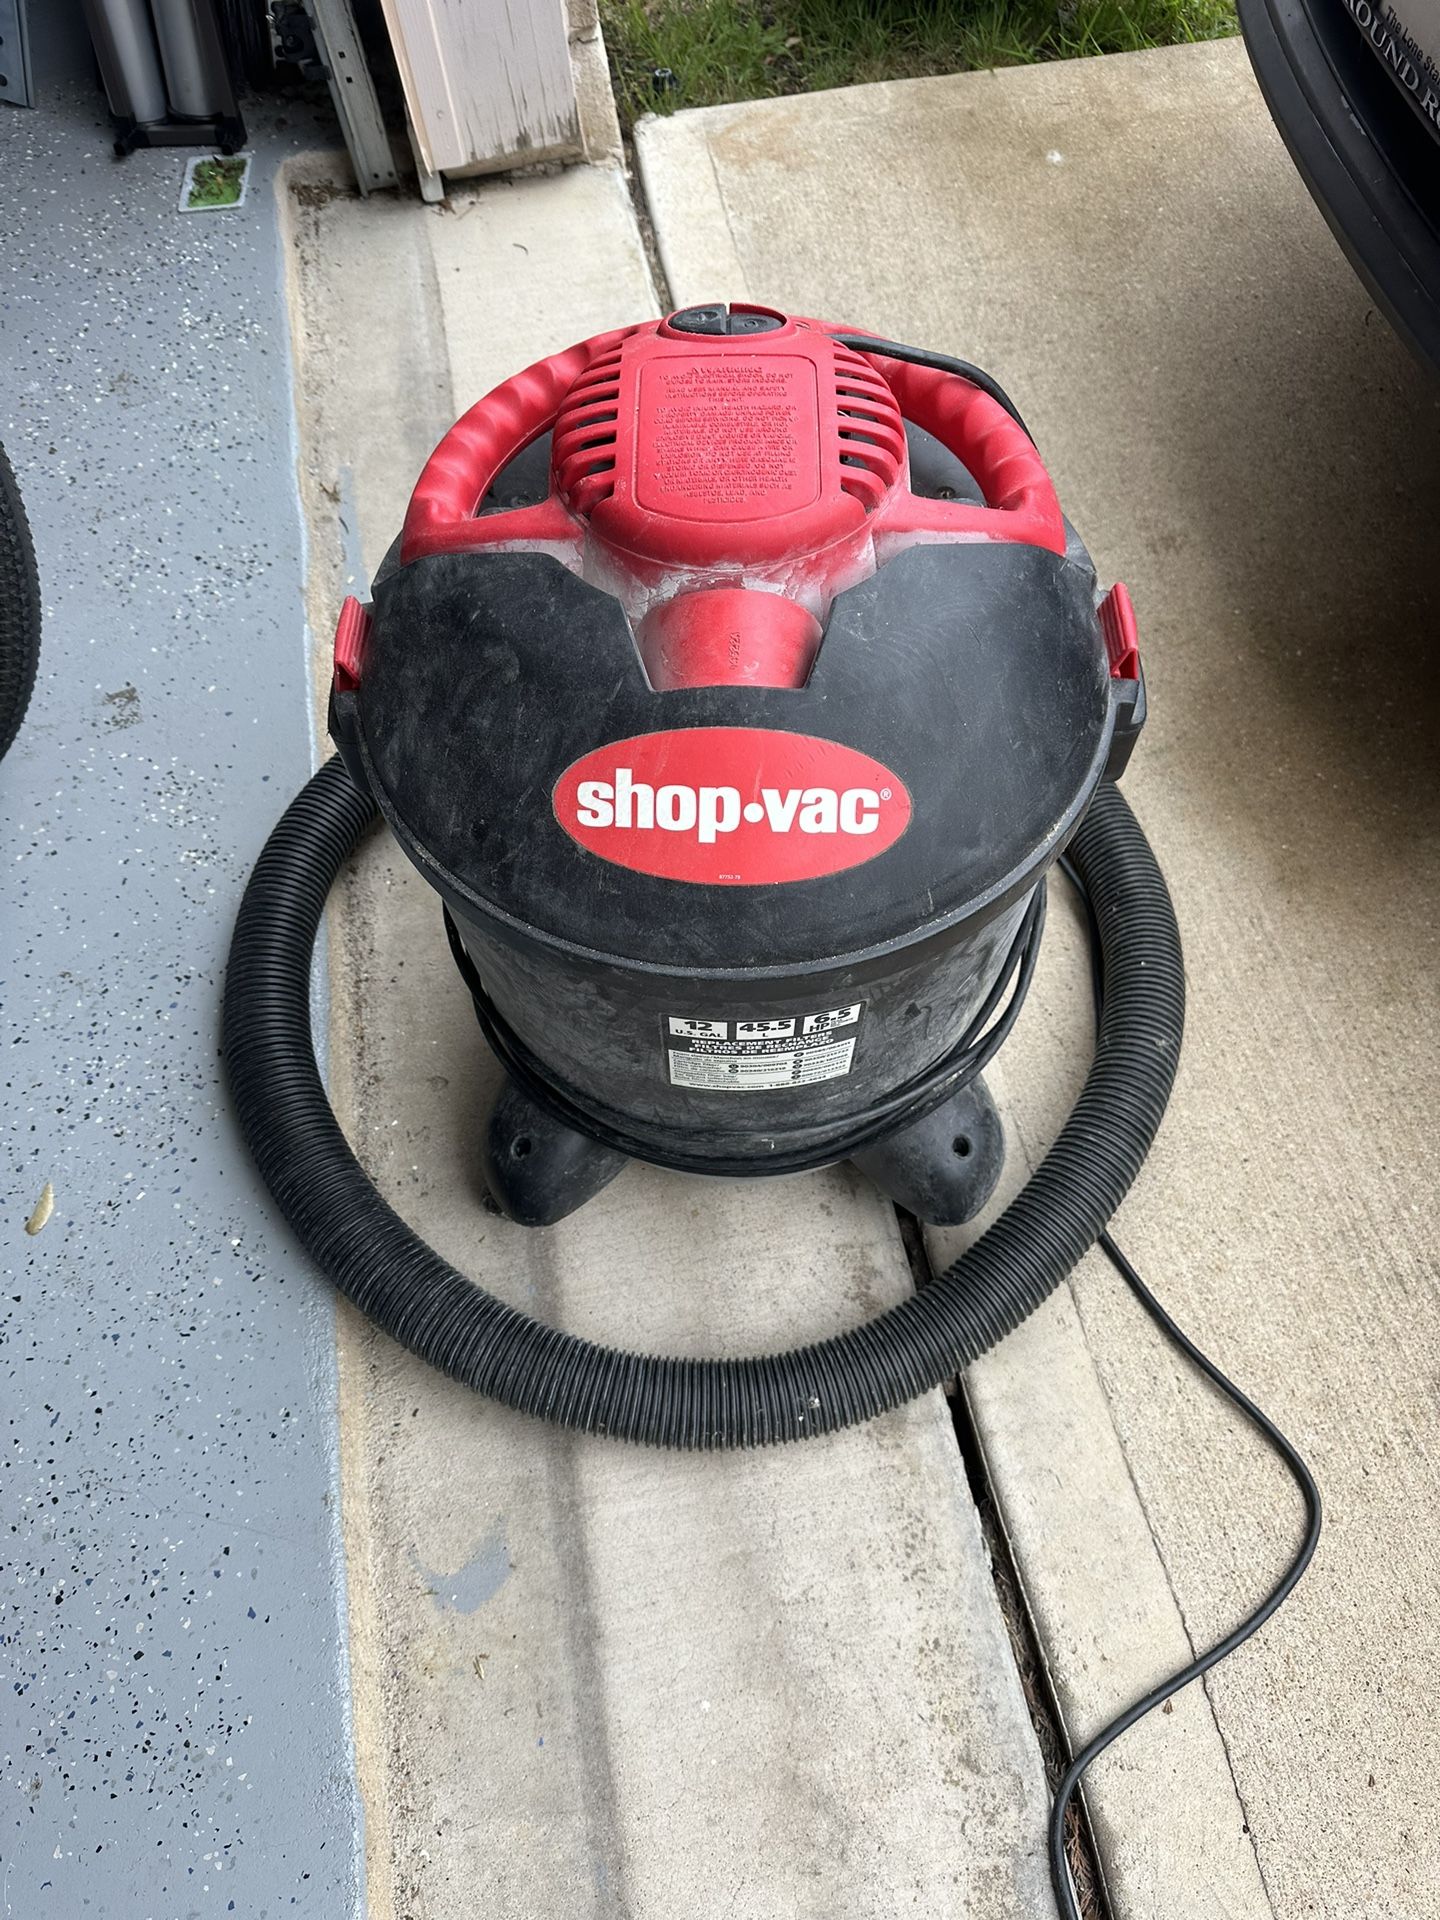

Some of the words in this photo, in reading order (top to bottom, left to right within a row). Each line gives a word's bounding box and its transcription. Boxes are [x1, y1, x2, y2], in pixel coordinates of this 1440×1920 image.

[1386, 5, 1402, 34] The
[1401, 26, 1424, 61] Lone
[1420, 88, 1440, 130] R
[814, 1008, 852, 1024] 6.5
[675, 1028, 698, 1037] U.S.
[684, 1020, 713, 1032] 12
[738, 1020, 792, 1033] 45.5
[809, 1022, 830, 1032] HP
[692, 1038, 781, 1046] REPLACEMENT
[786, 1030, 832, 1043] FILTERS
[766, 1036, 830, 1049] RECHANGE
[761, 1038, 834, 1054] REEMPLAZO
